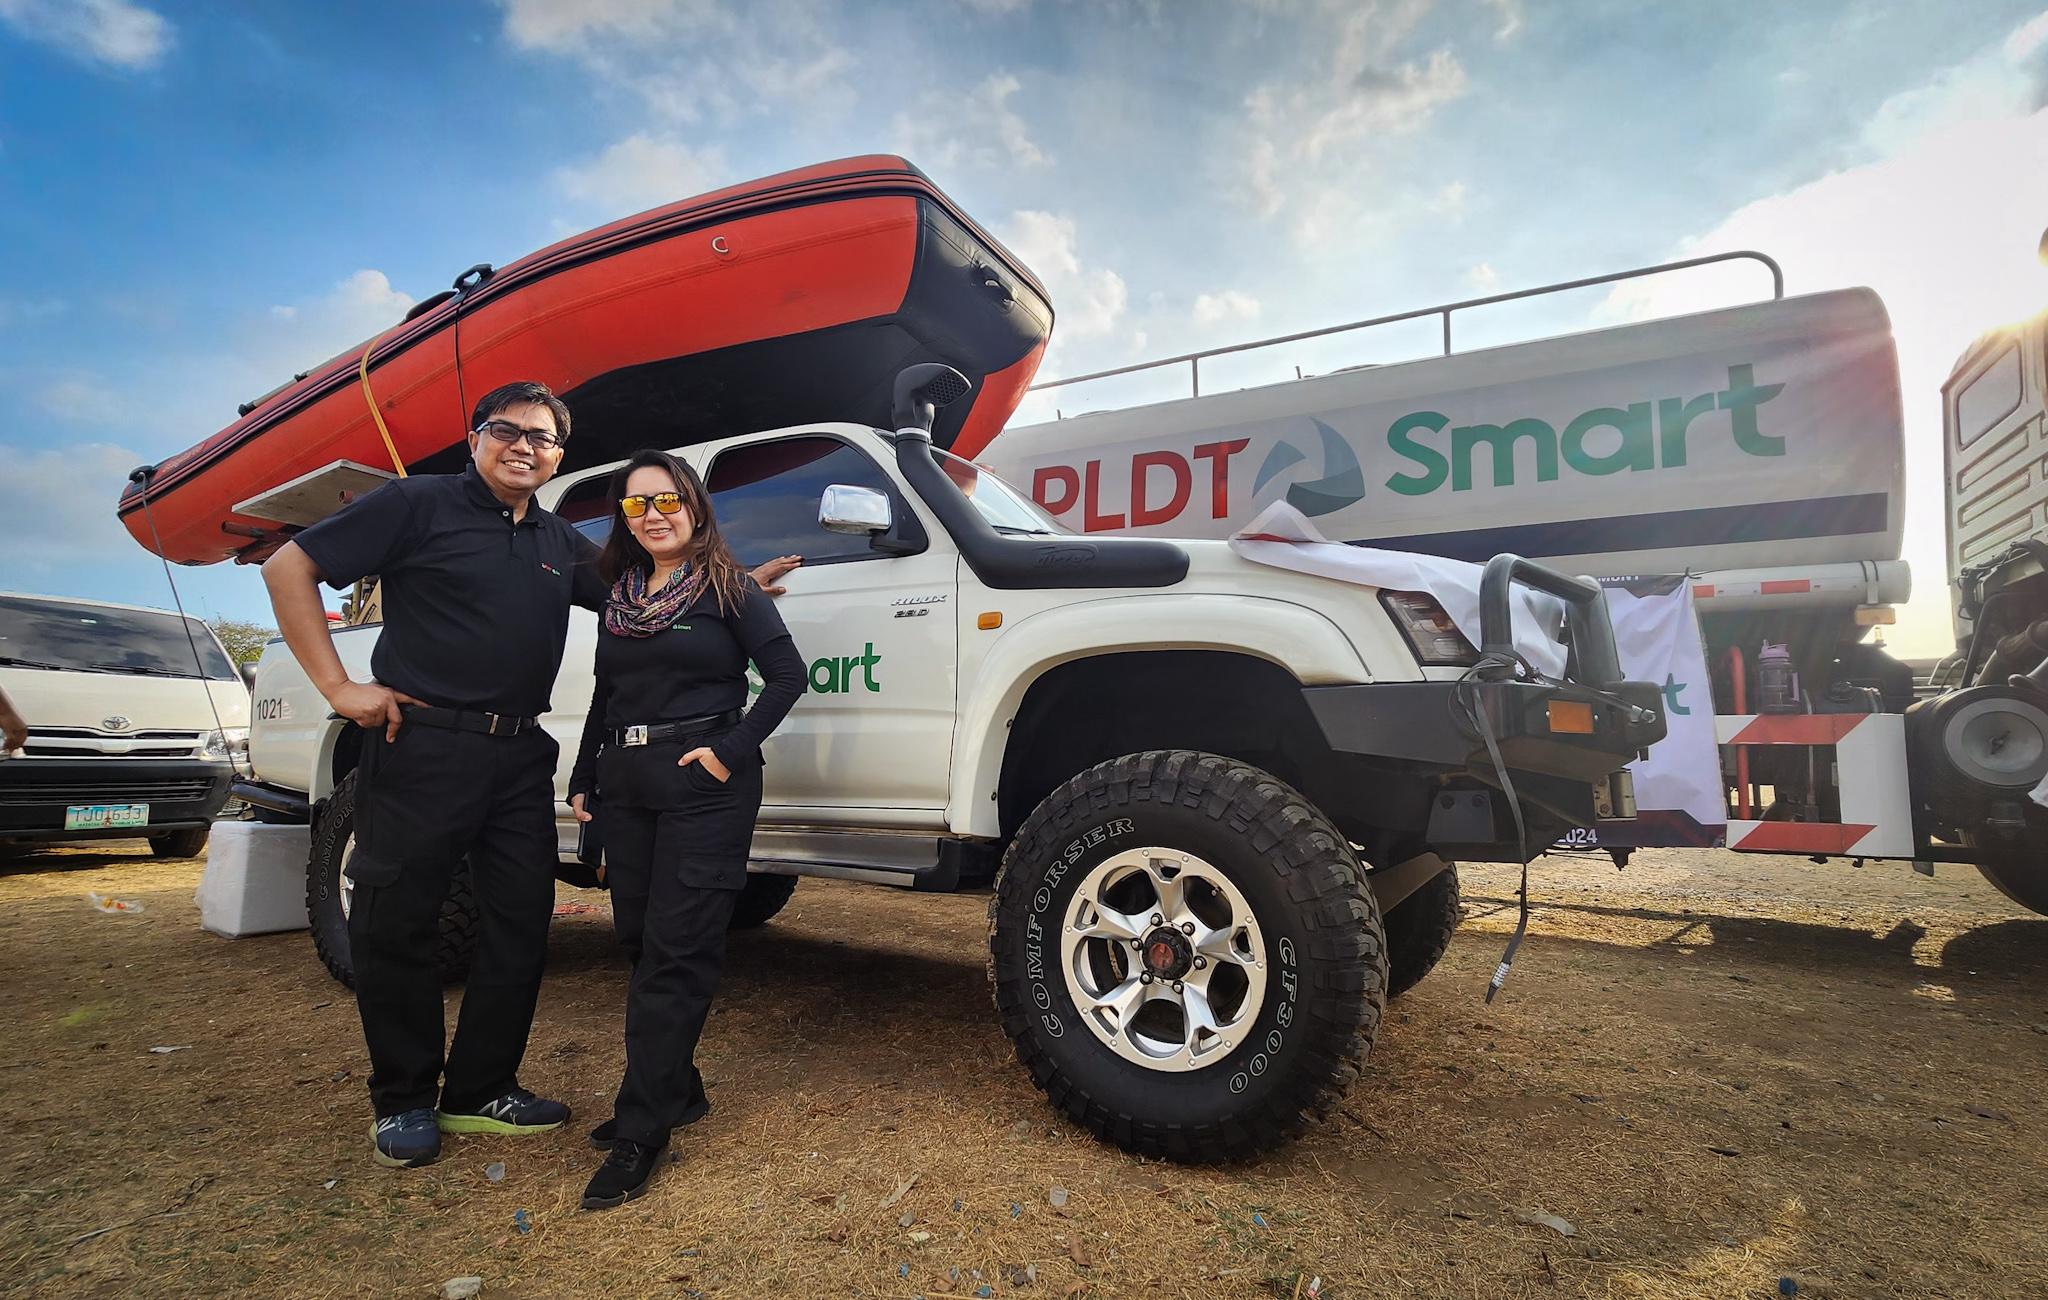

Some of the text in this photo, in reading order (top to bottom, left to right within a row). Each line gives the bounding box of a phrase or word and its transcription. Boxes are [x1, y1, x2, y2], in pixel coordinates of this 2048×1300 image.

[1031, 362, 1787, 533] PLDT Smart
[256, 697, 283, 721] 1021
[1025, 817, 1136, 1039] COMFORSER
[1228, 936, 1299, 1095] CF3000
